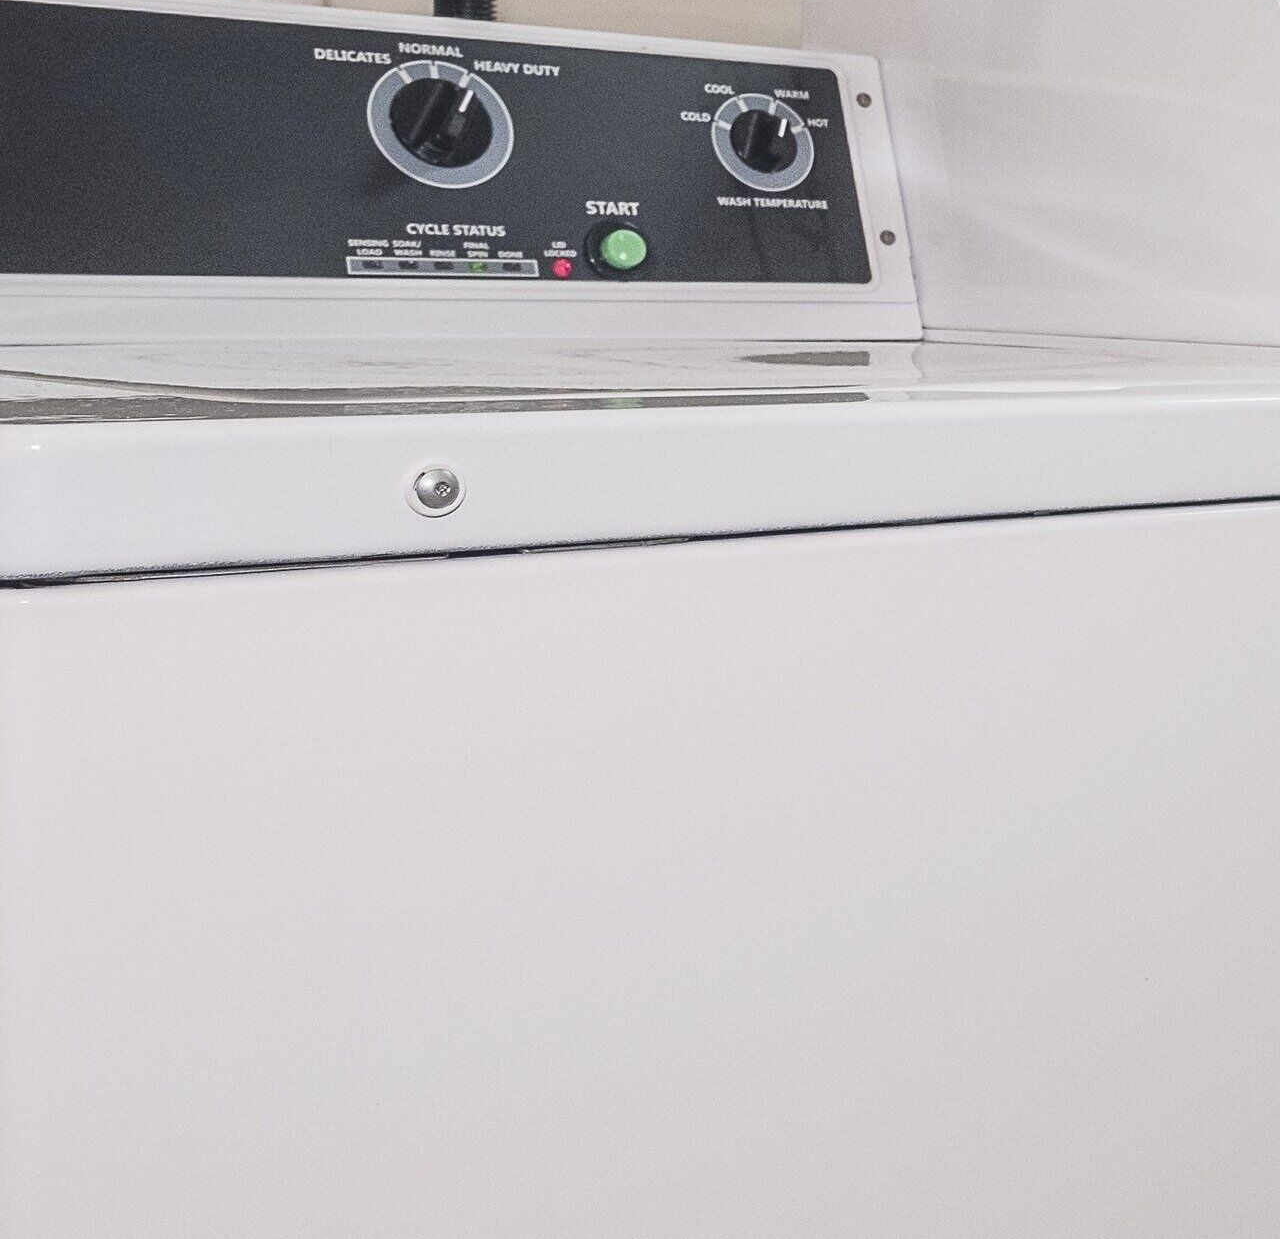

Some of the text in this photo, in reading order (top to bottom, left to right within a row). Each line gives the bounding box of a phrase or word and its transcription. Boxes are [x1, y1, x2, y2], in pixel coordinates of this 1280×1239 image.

[314, 48, 391, 64] DELICATES
[398, 42, 463, 58] NORMAL
[474, 60, 560, 76] HEAVY DUTY
[704, 84, 734, 95] COOL
[774, 89, 809, 99] WARM
[680, 111, 711, 122] COLD
[807, 118, 828, 127] HOT
[586, 201, 639, 215] START
[717, 197, 828, 209] WASH TEMPERATURE
[406, 223, 506, 237] CYCLE STATUS
